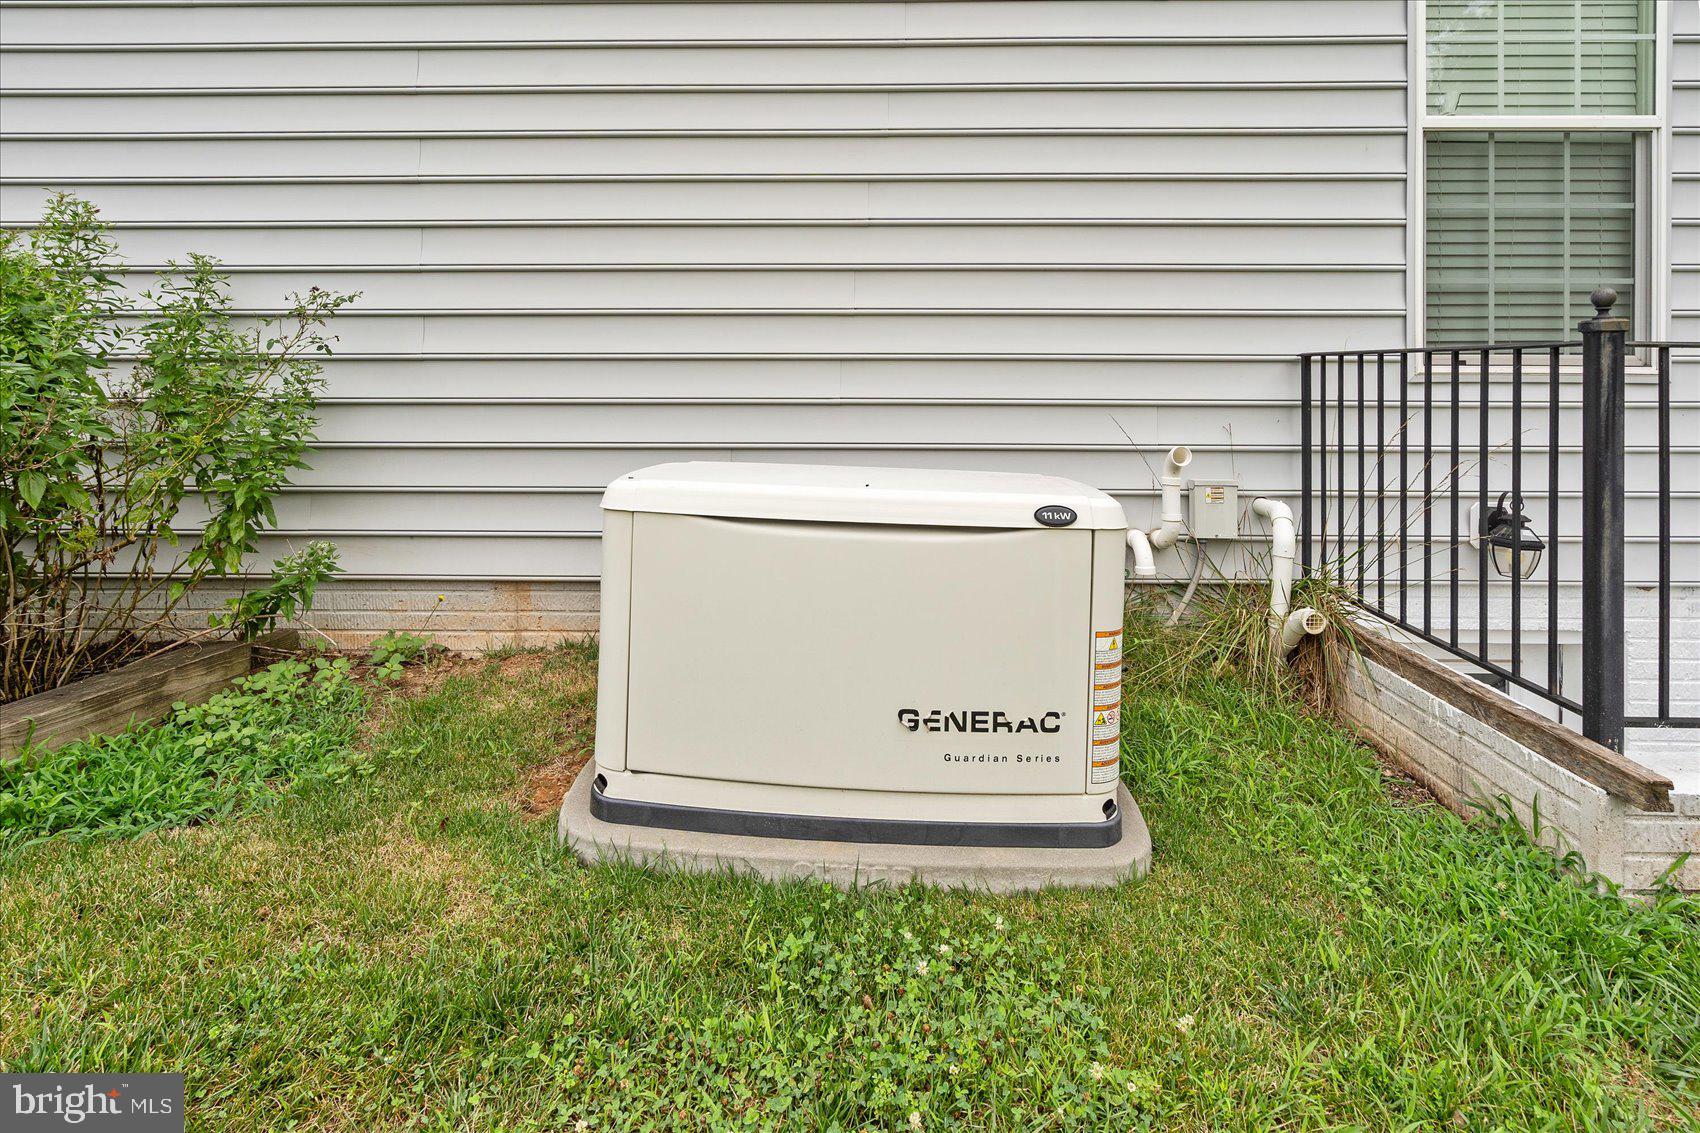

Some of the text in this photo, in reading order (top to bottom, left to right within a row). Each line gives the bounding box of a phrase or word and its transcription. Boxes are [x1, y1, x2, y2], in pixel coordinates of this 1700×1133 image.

[897, 708, 1061, 733] GENERAC
[943, 753, 1061, 763] Guardian Series
